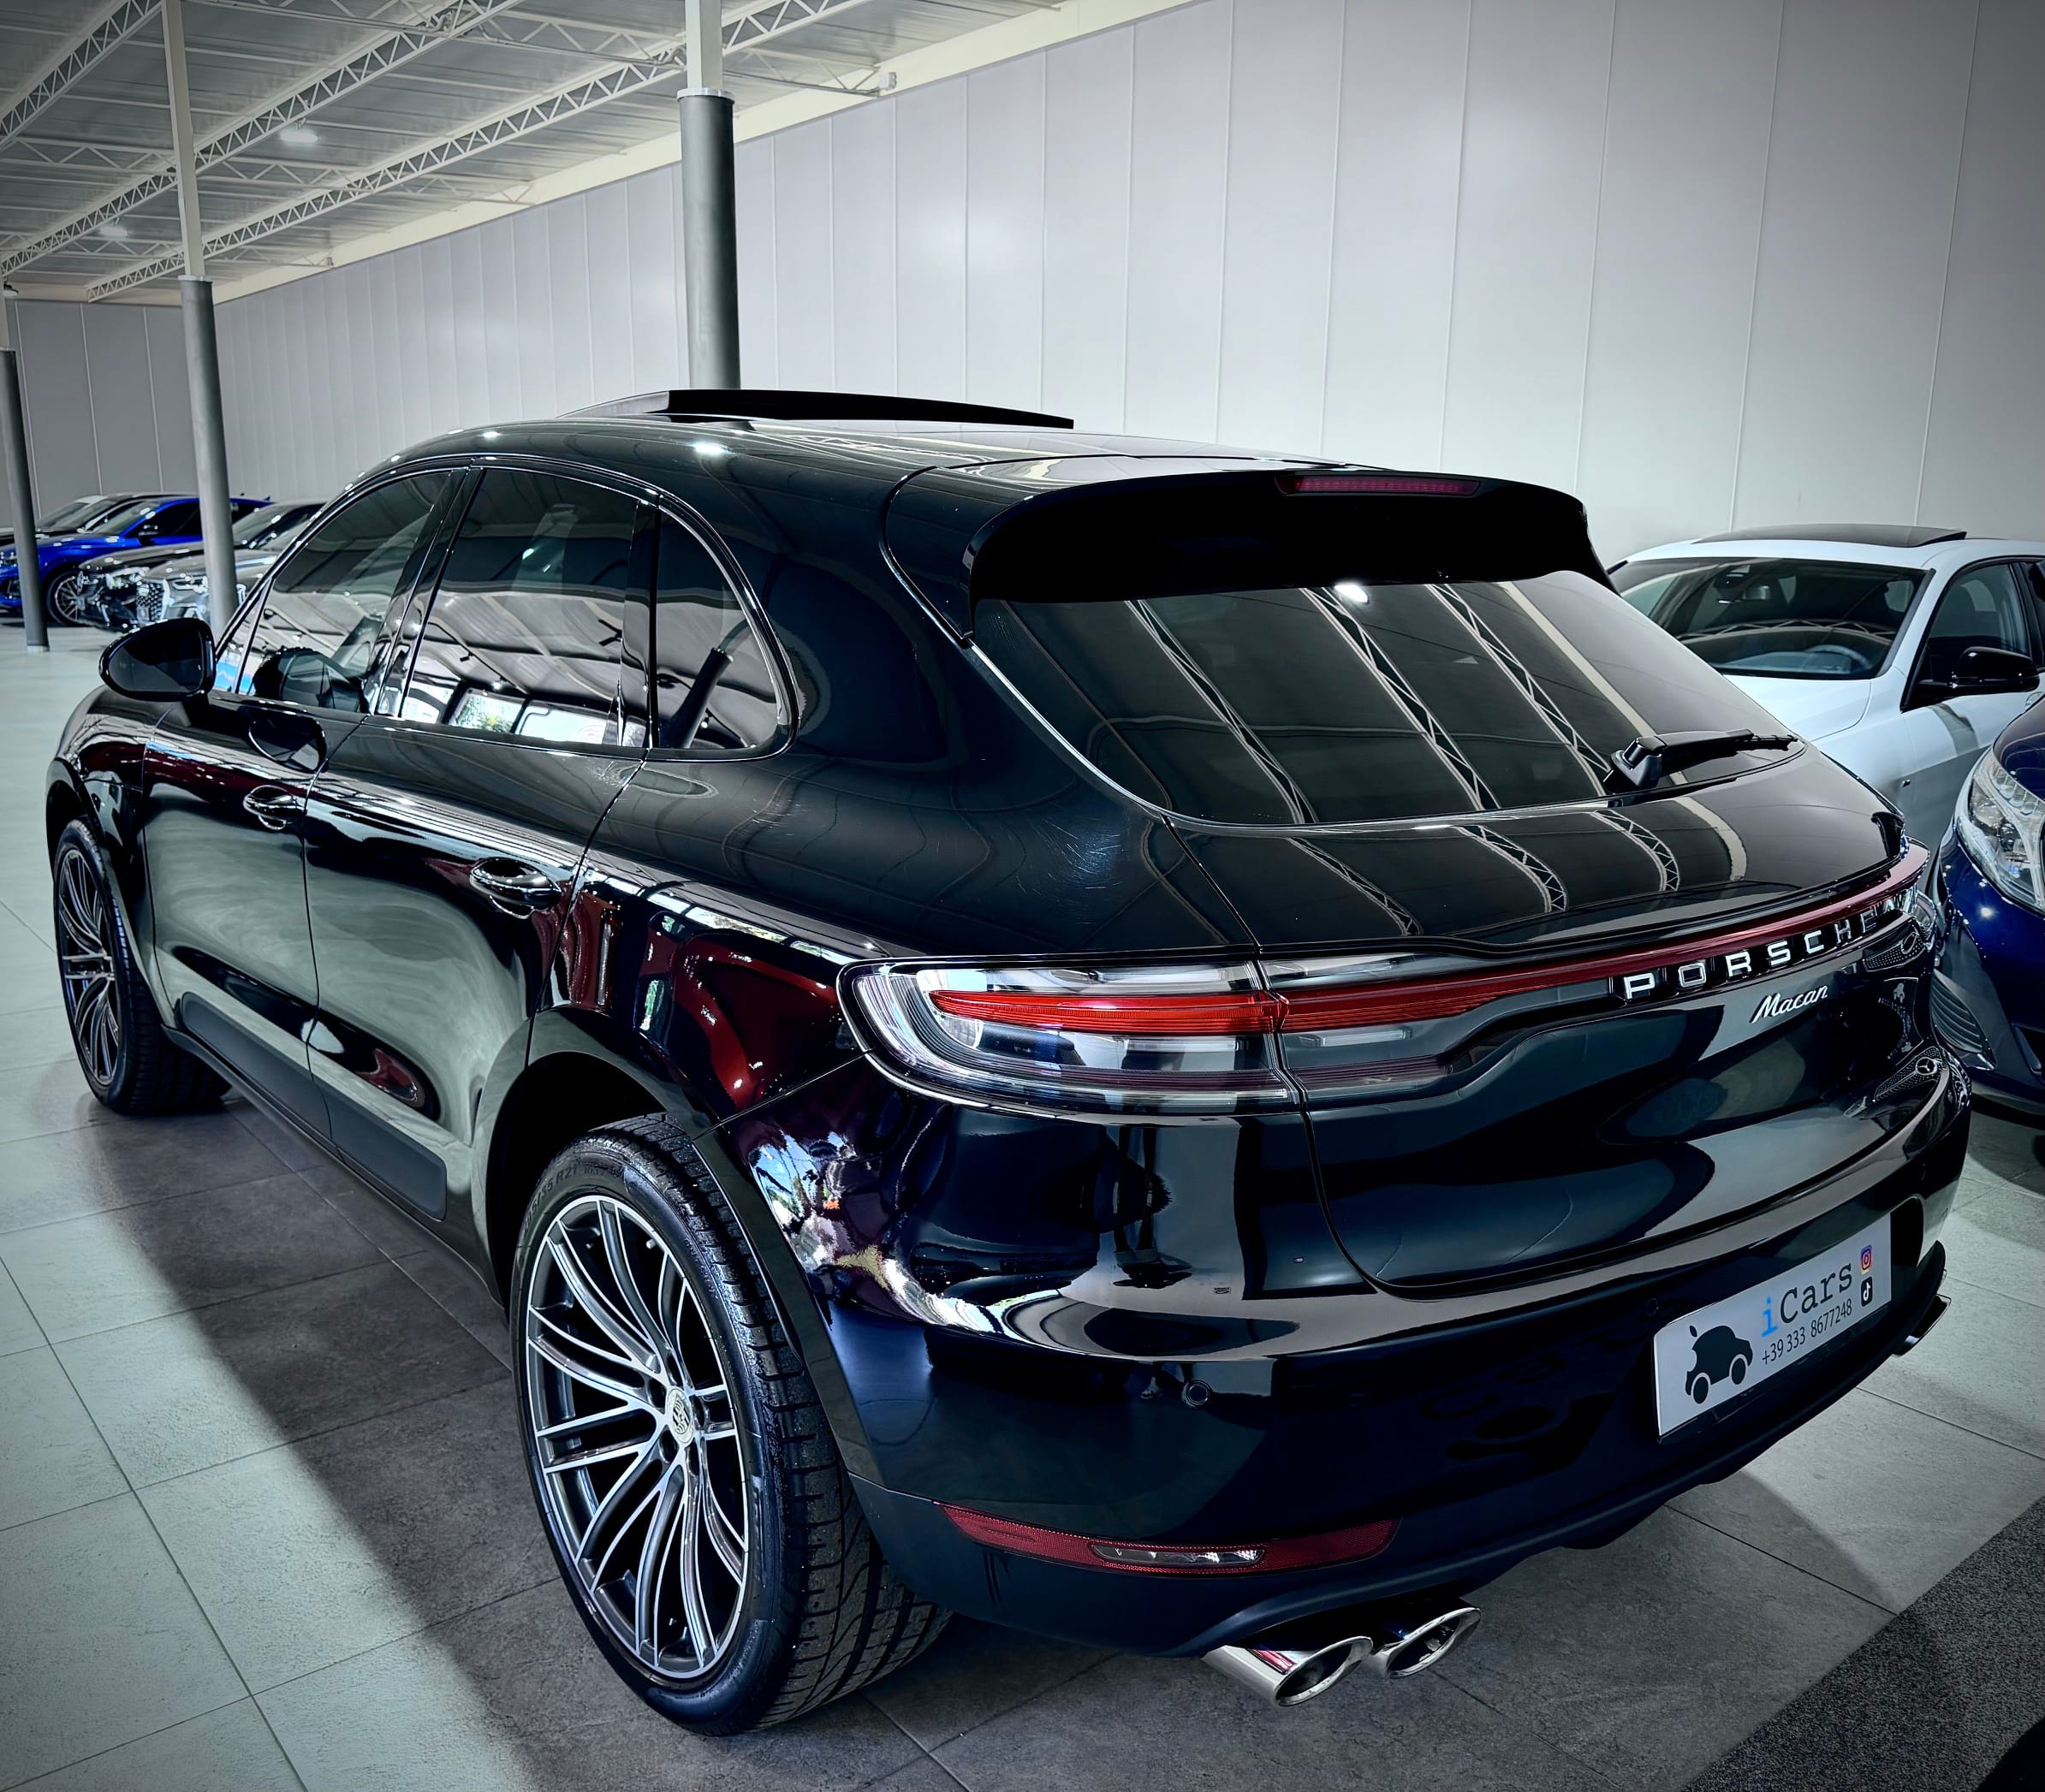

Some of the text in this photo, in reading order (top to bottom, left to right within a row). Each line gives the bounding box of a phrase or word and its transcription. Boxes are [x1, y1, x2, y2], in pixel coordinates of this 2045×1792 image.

[1623, 909, 1877, 1000] PORSCHE
[1750, 985, 1828, 1024] Macan
[1762, 1298, 1852, 1365] +39 333 8677248
